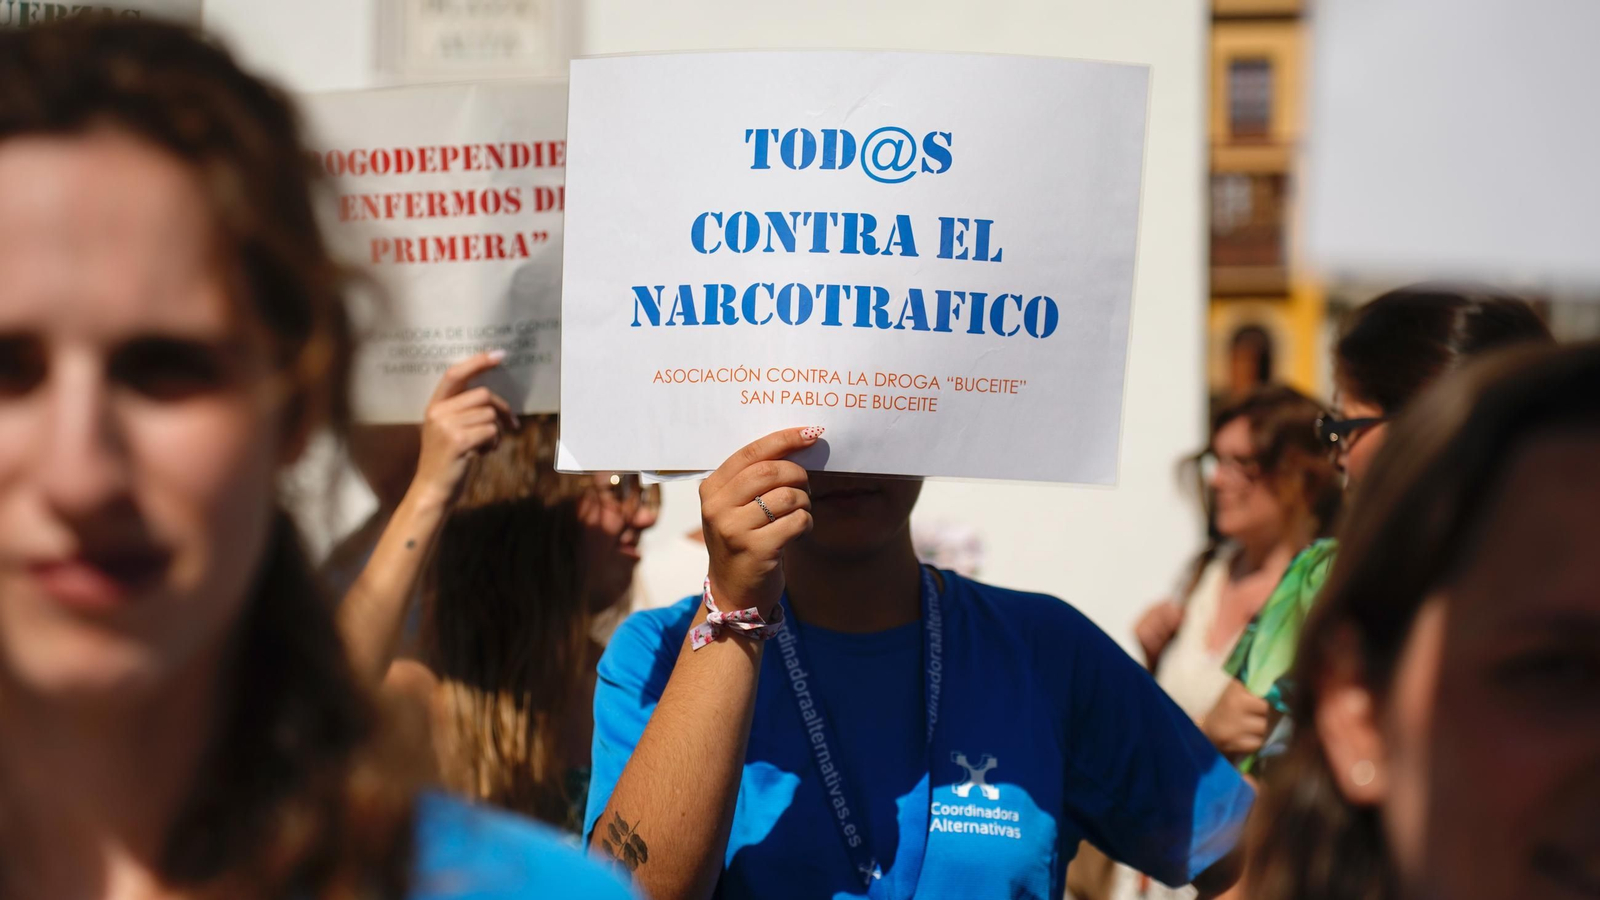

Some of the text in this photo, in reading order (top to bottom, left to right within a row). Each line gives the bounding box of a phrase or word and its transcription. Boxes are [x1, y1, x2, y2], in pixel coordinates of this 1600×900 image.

[745, 127, 952, 184] TOD@S
[338, 187, 521, 222] ENFERMOS
[370, 231, 549, 264] PRIMERA”
[691, 211, 1002, 262] CONTRA EL
[631, 283, 1059, 338] NARCOTRAFICO
[653, 364, 1027, 395] ASOCIACIÓN CONTRA LA DROGA “BUCEITE”
[740, 390, 938, 412] SAN PABLO DE BUCEITE
[931, 800, 1020, 822] Coordinadora
[929, 817, 1022, 839] Alternativas
